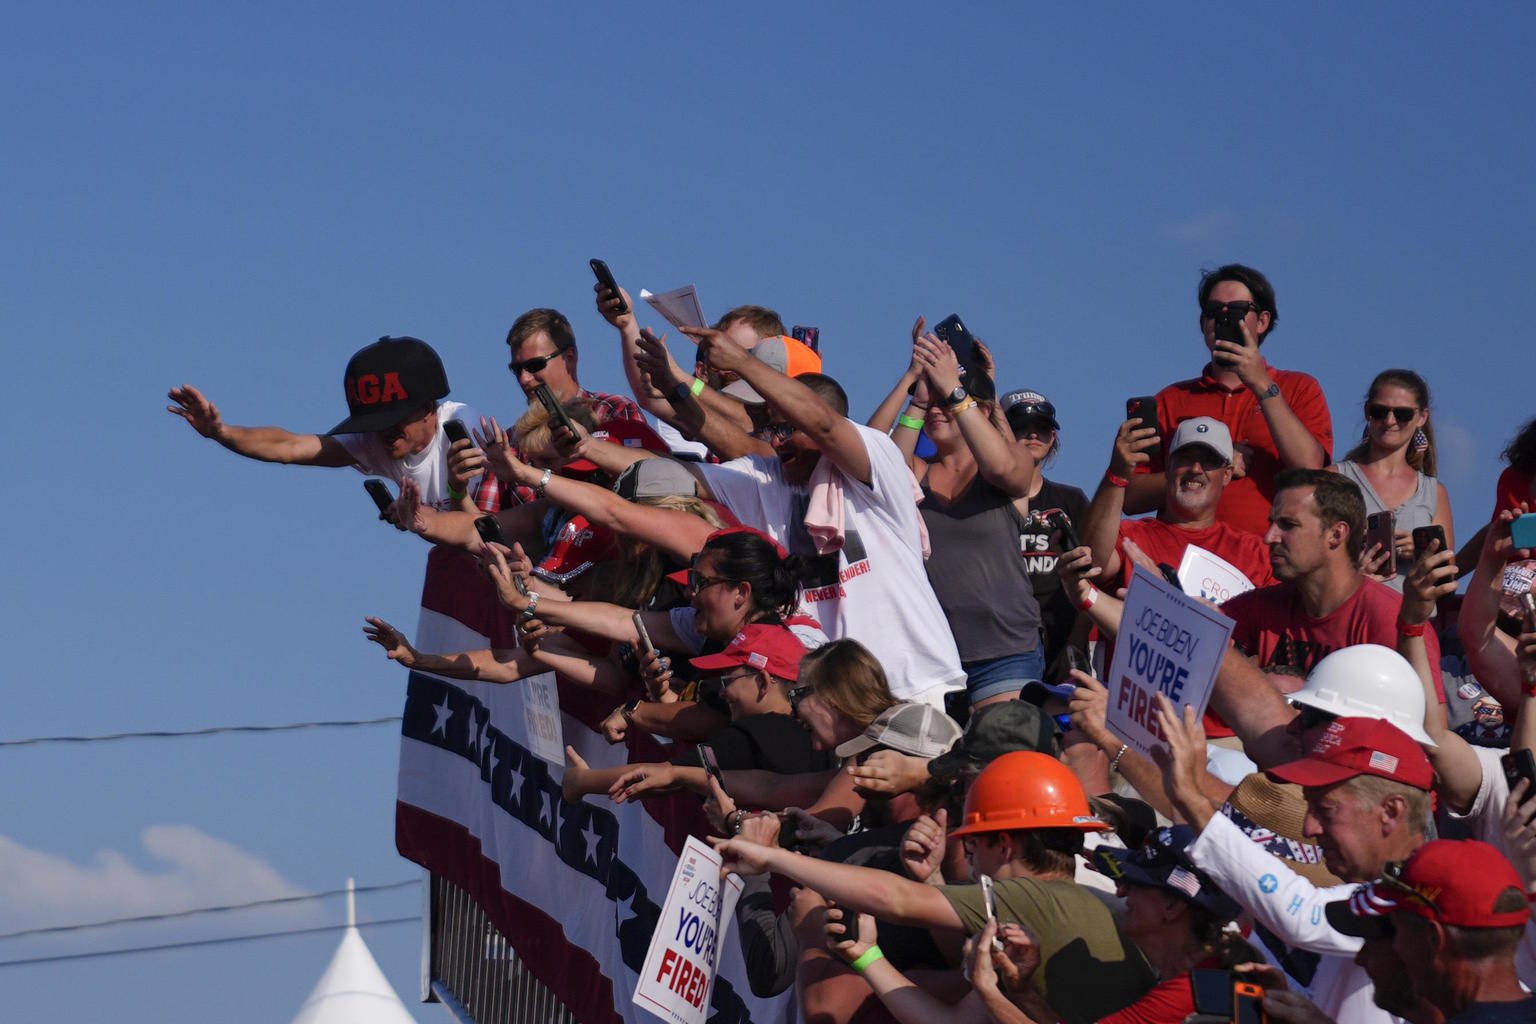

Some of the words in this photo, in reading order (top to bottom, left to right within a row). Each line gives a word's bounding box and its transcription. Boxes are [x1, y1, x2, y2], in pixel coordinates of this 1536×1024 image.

[346, 371, 409, 405] AGA
[1202, 578, 1230, 601] CRO
[1135, 605, 1162, 637] JOE
[1158, 618, 1200, 663] BIDEN,
[1127, 633, 1190, 703] YOU'RE
[688, 880, 714, 909] JOE
[656, 947, 710, 1013] FIRED!
